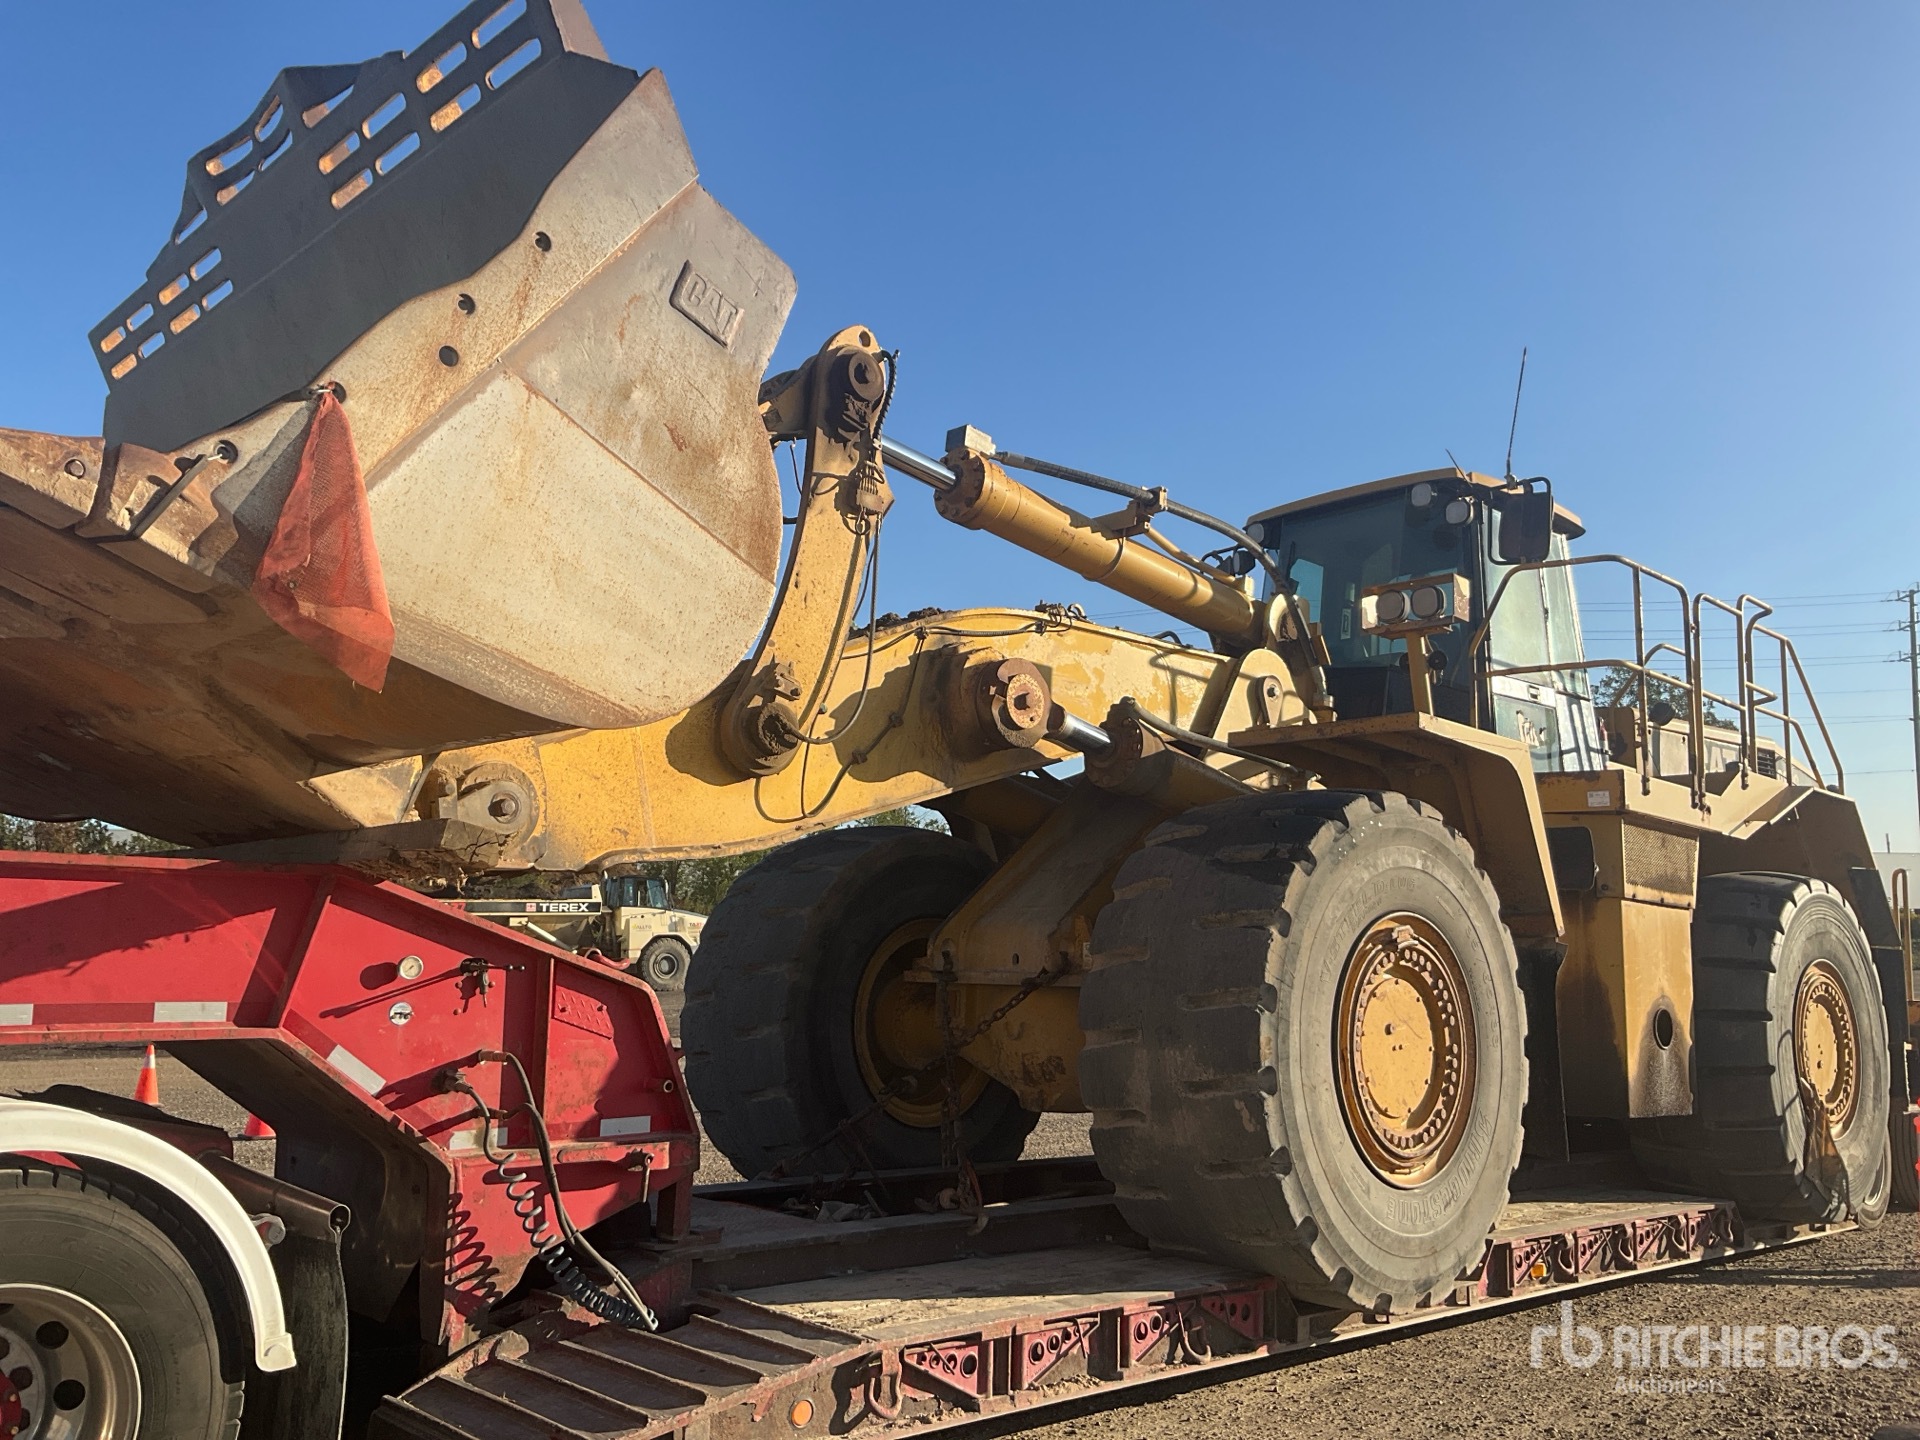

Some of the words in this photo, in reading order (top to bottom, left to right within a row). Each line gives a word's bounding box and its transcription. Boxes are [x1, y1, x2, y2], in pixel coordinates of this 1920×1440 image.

[681, 272, 738, 336] CAT
[1703, 744, 1737, 773] AT
[539, 902, 589, 912] TEREX
[1386, 1107, 1493, 1225] BRIDGESTONE
